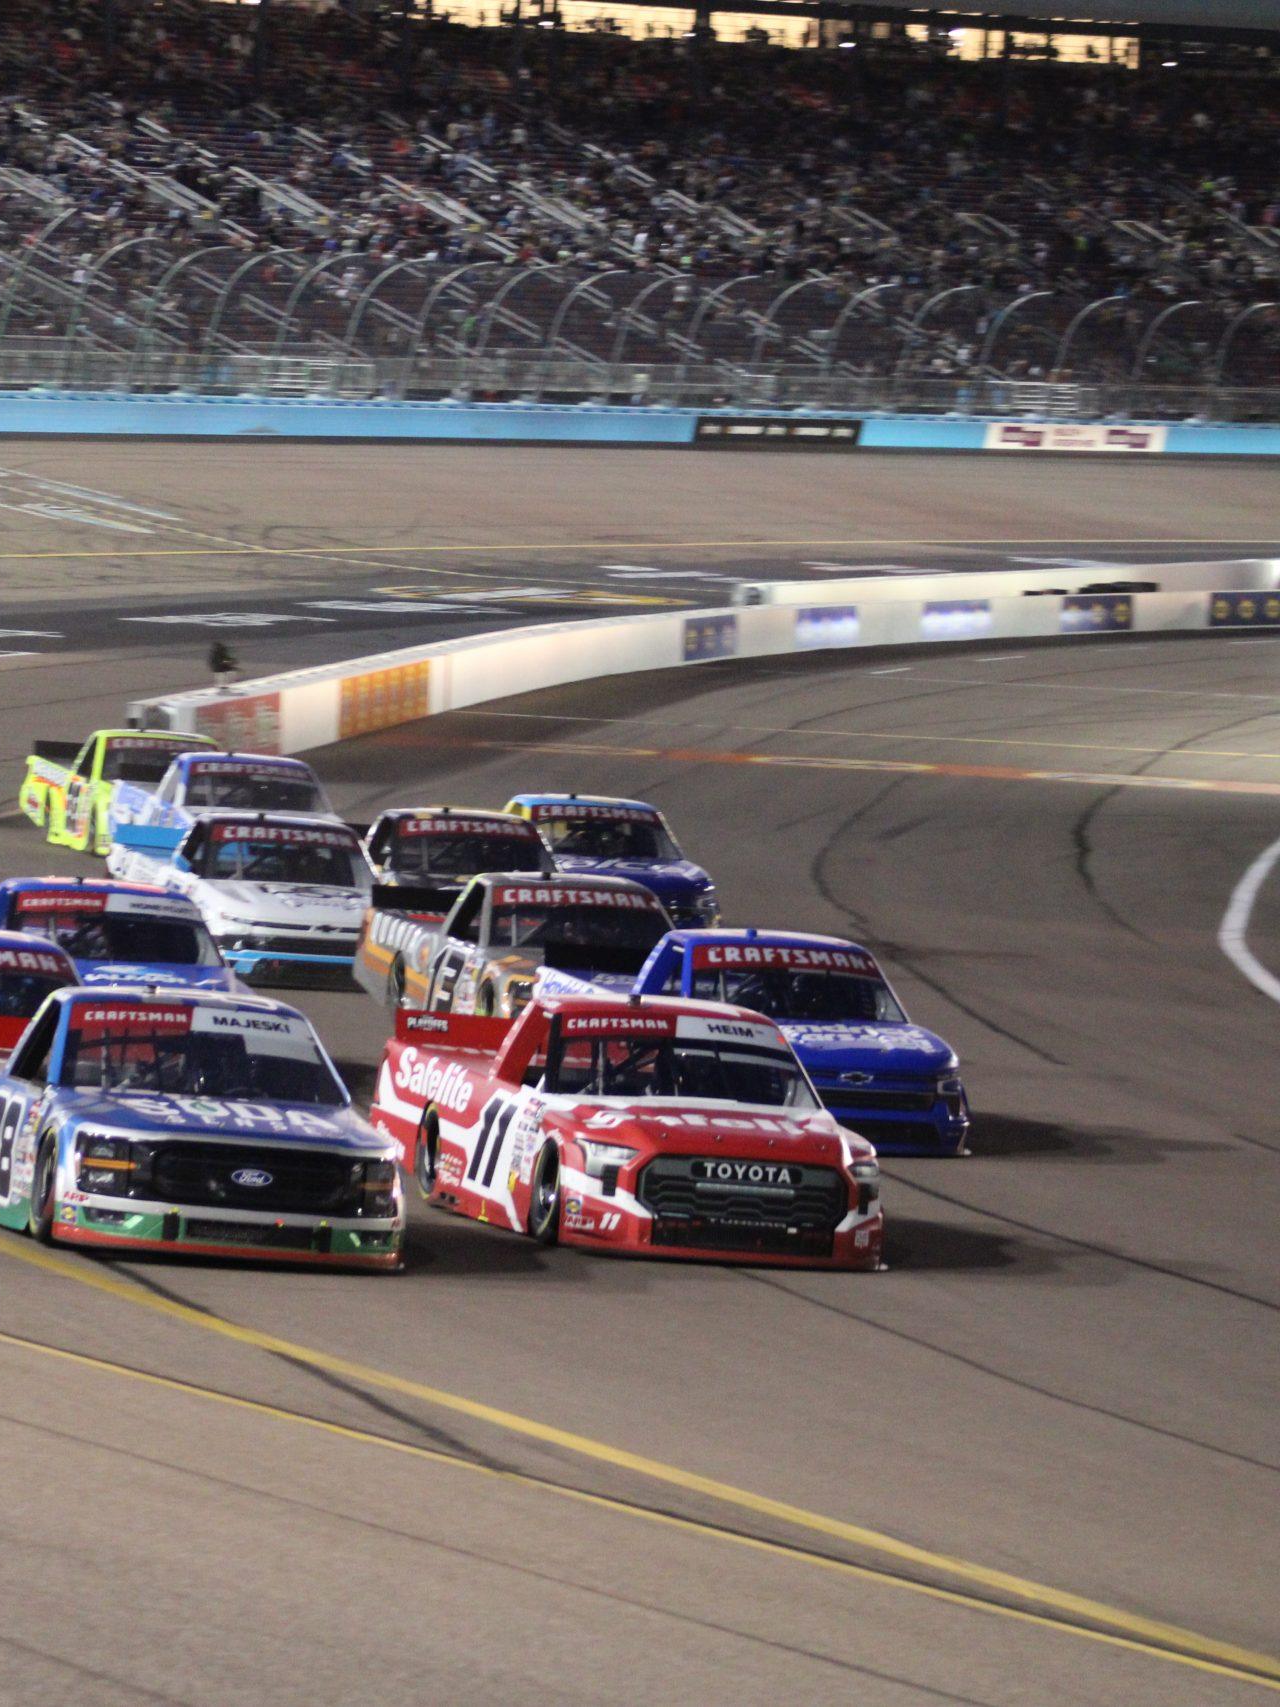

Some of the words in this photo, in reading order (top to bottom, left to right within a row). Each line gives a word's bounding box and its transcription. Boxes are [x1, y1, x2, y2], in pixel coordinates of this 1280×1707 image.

[538, 805, 655, 823] CRAFTSMAN
[223, 825, 356, 847] CRAFTSMAN
[407, 820, 529, 836] CRAFTSMAN
[502, 889, 646, 909] CRAFTSMAN
[707, 946, 868, 970] CRAFTSMAN
[84, 1010, 189, 1024] CRAFTSMAN
[212, 1015, 291, 1034] MAJESKI
[566, 1017, 669, 1030] CRAFTSMAN
[707, 1023, 755, 1039] HEIM
[395, 1046, 474, 1113] Safelite
[117, 1098, 342, 1134] SODA
[467, 1097, 519, 1188] 11
[235, 1170, 269, 1186] Ford
[703, 1161, 793, 1184] TOYOTA
[599, 1211, 622, 1231] 11
